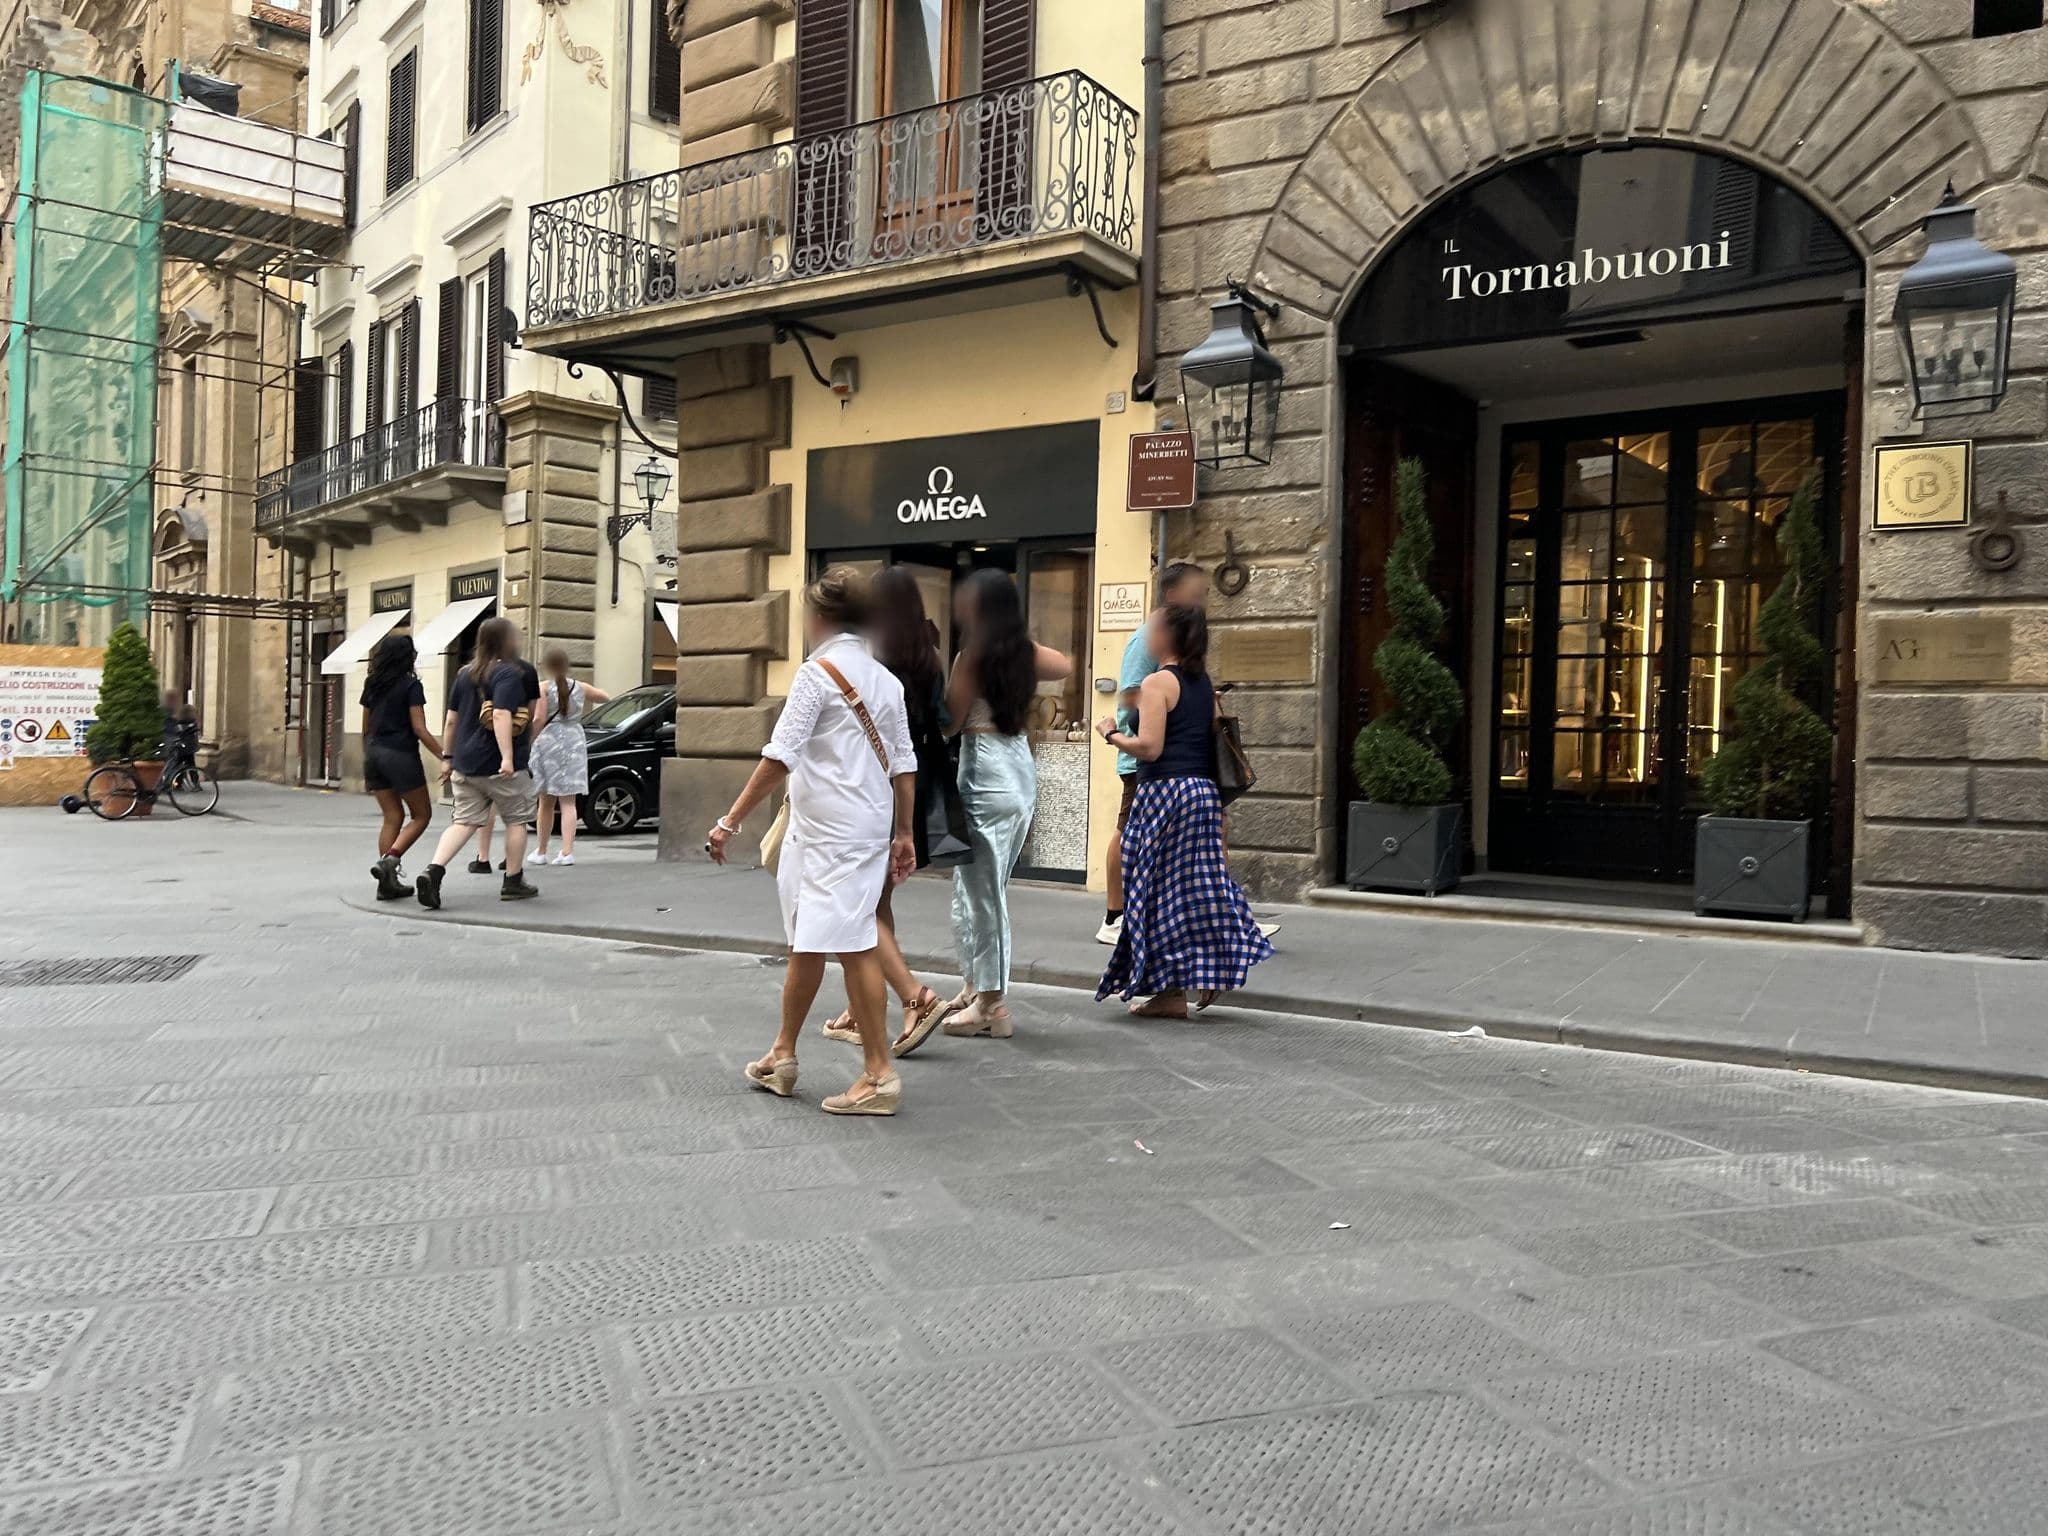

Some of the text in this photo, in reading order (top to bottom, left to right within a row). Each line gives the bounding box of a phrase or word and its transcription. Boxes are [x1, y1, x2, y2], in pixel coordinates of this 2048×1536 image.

[1444, 239, 1460, 254] IL
[1441, 230, 1733, 300] Tornabuoni
[1145, 440, 1182, 449] PALAZZO
[1139, 449, 1188, 459] MINERBETTI
[897, 494, 987, 523] OMEGA
[458, 577, 492, 595] VALENTINO
[1103, 599, 1141, 610] OMEGA
[21, 681, 85, 690] COSTRUZIONI
